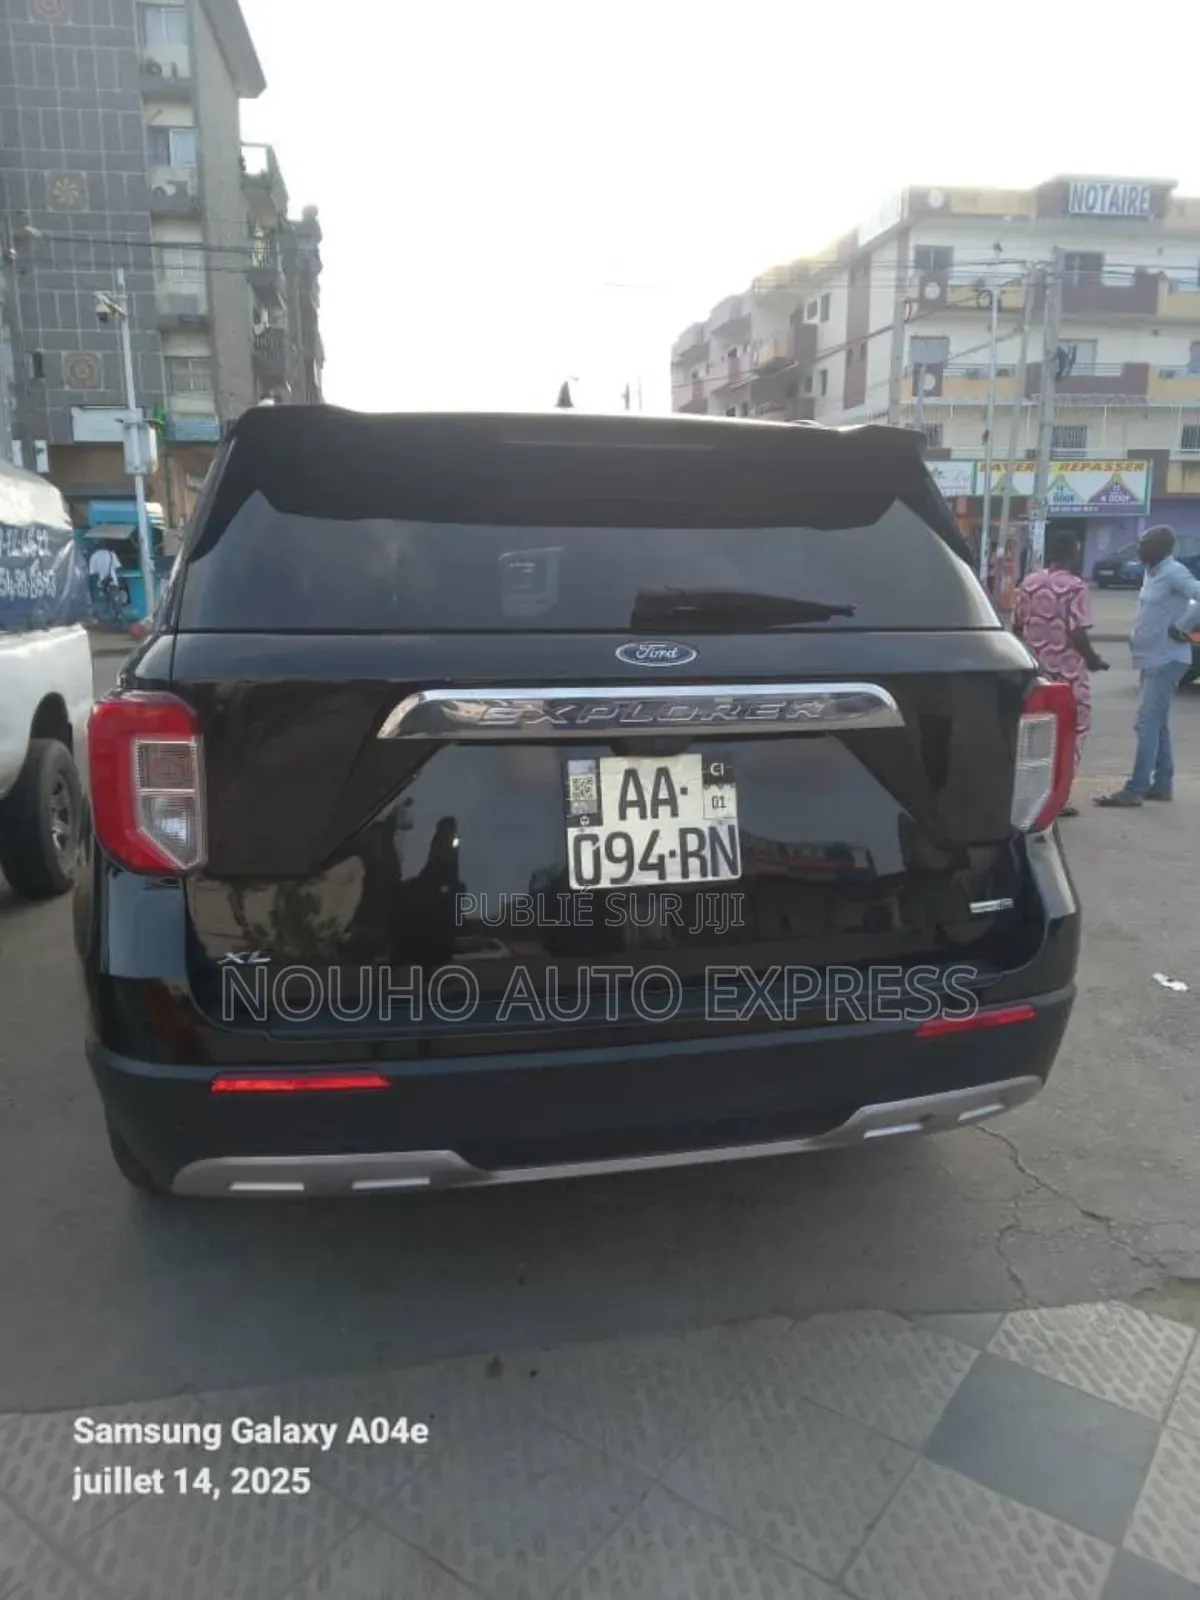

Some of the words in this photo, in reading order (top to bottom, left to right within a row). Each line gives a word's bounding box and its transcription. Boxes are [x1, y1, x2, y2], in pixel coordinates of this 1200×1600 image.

[1070, 182, 1150, 215] NOTAIRE
[1059, 462, 1145, 472] REPASSER
[635, 643, 680, 663] Ford
[479, 698, 827, 726] EXPLORER
[709, 762, 725, 777] CI
[711, 795, 727, 809] 01
